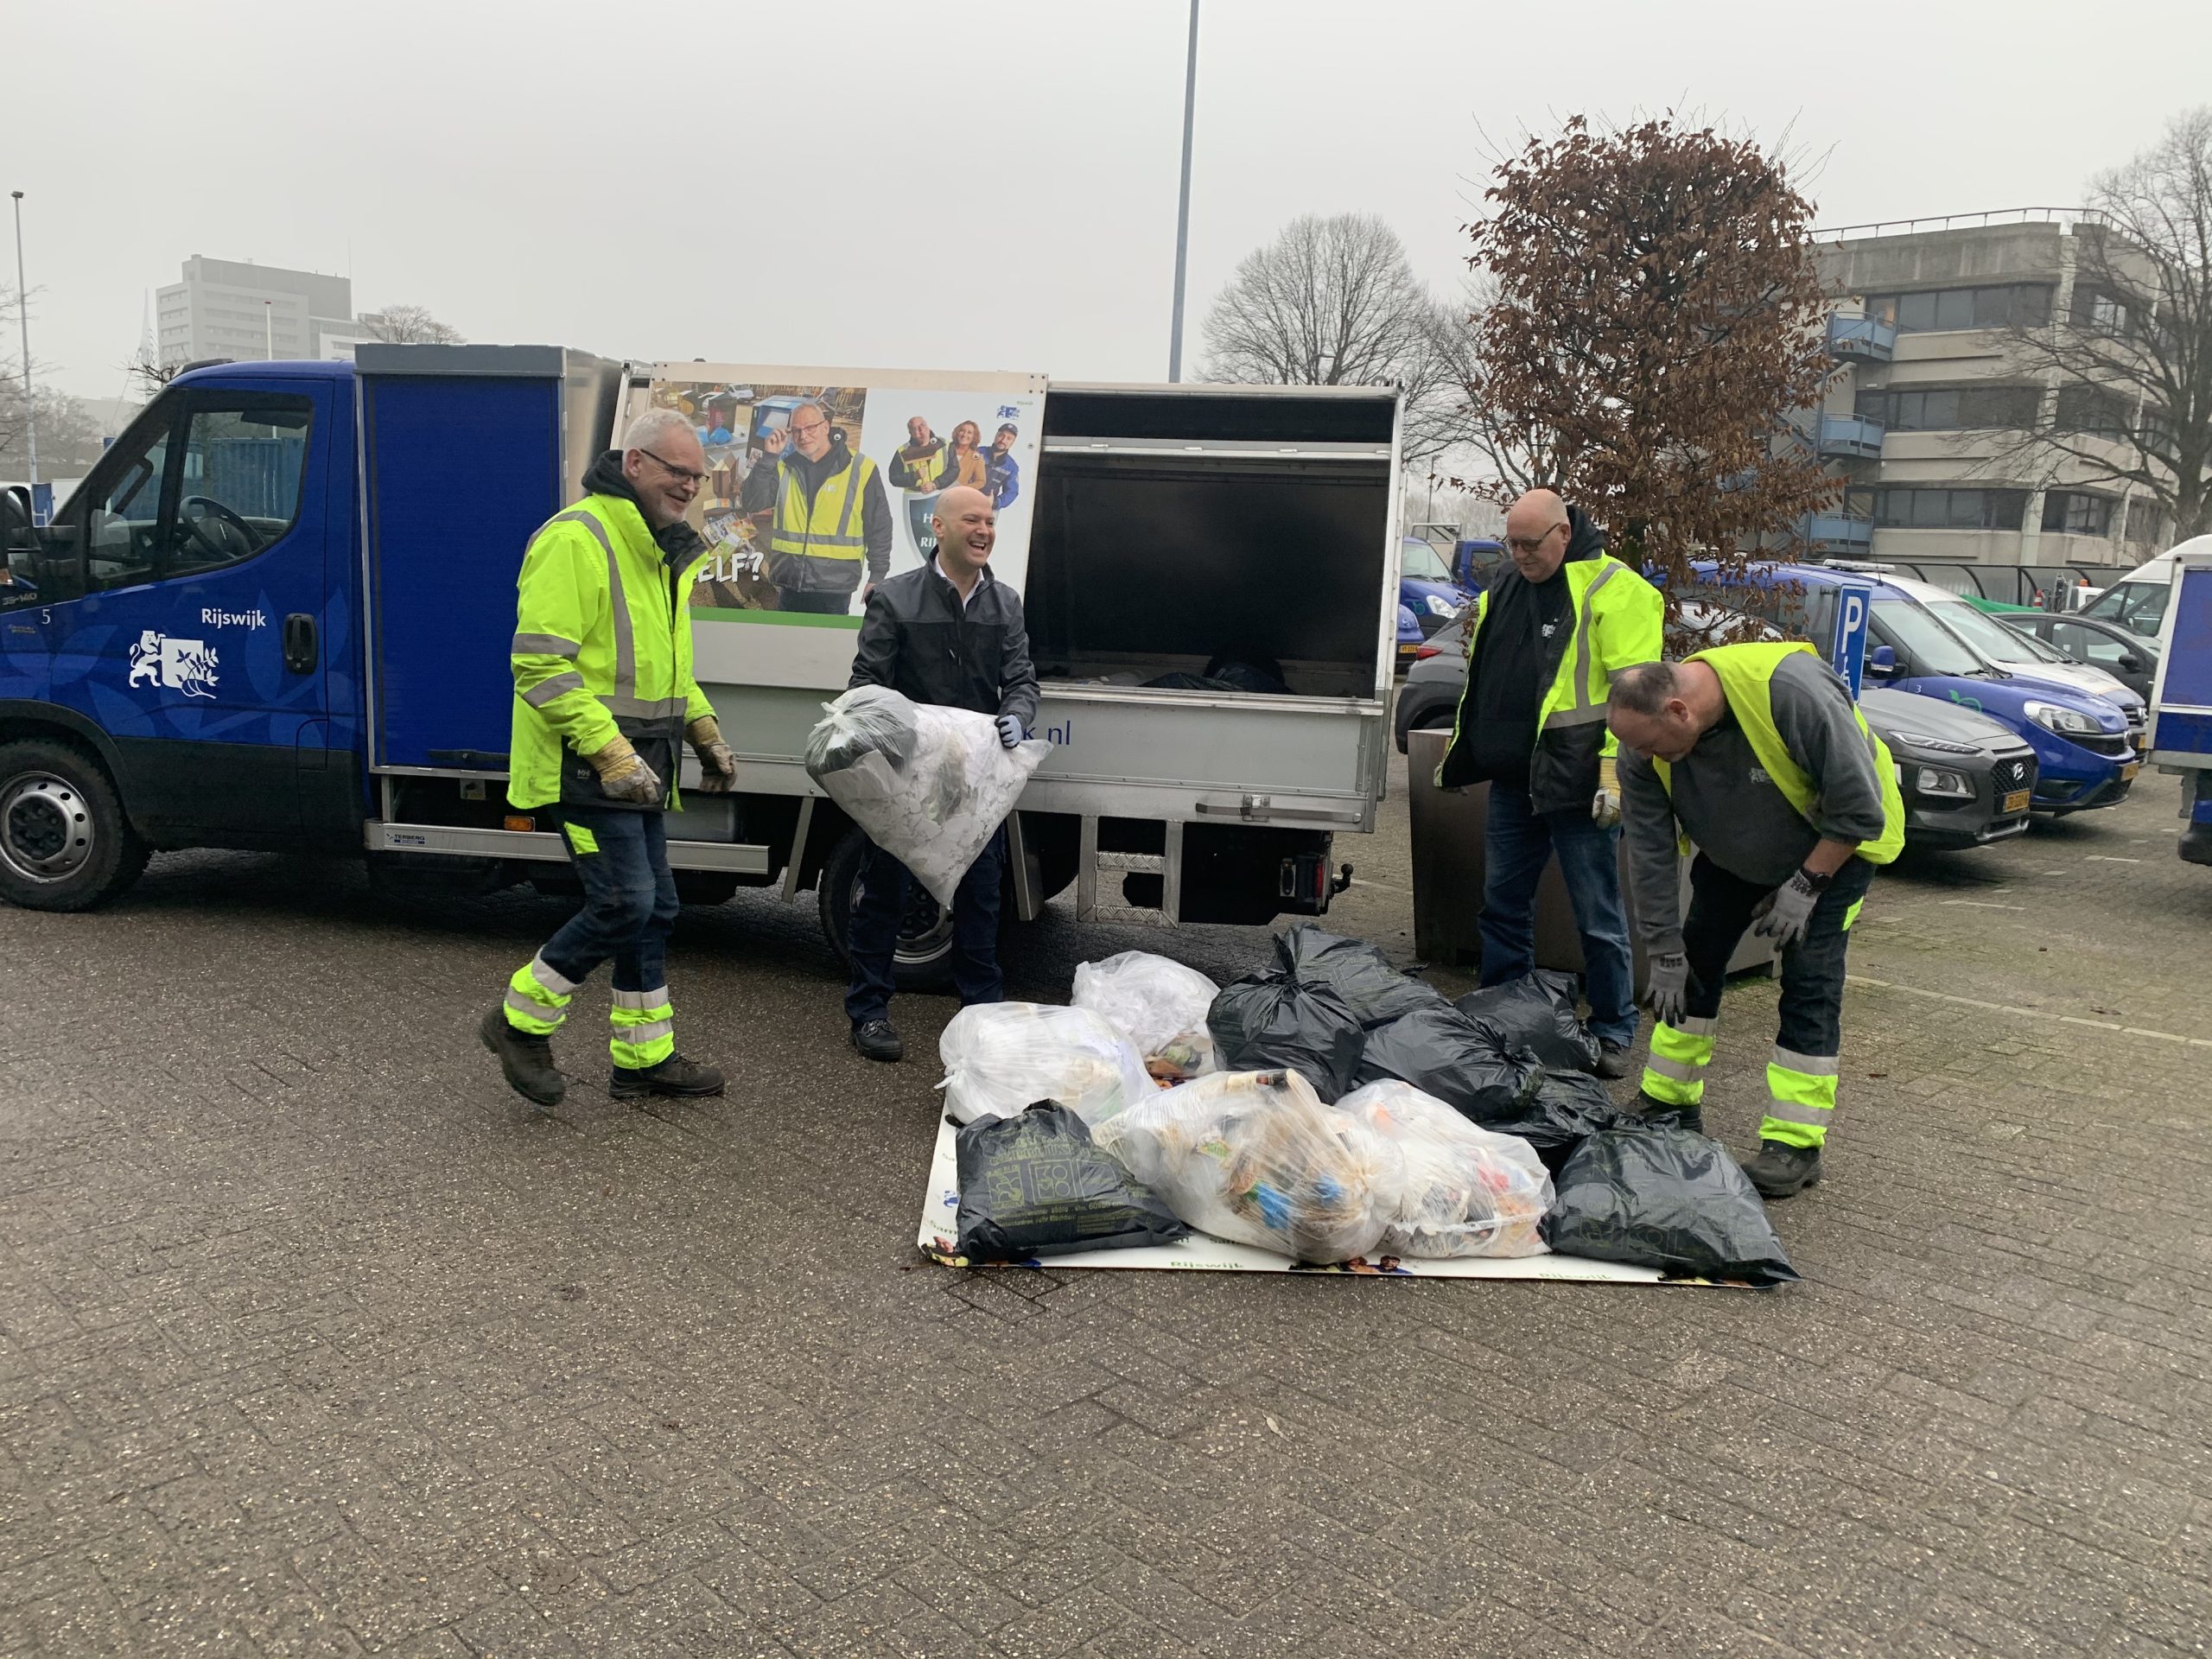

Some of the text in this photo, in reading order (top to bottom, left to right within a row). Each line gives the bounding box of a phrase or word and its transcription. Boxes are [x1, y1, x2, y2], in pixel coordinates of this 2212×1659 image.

[694, 552, 764, 583] ELF?
[41, 608, 51, 625] 5
[201, 607, 266, 632] Rijswijk
[1841, 595, 1863, 654] P
[1914, 684, 1923, 694] 3
